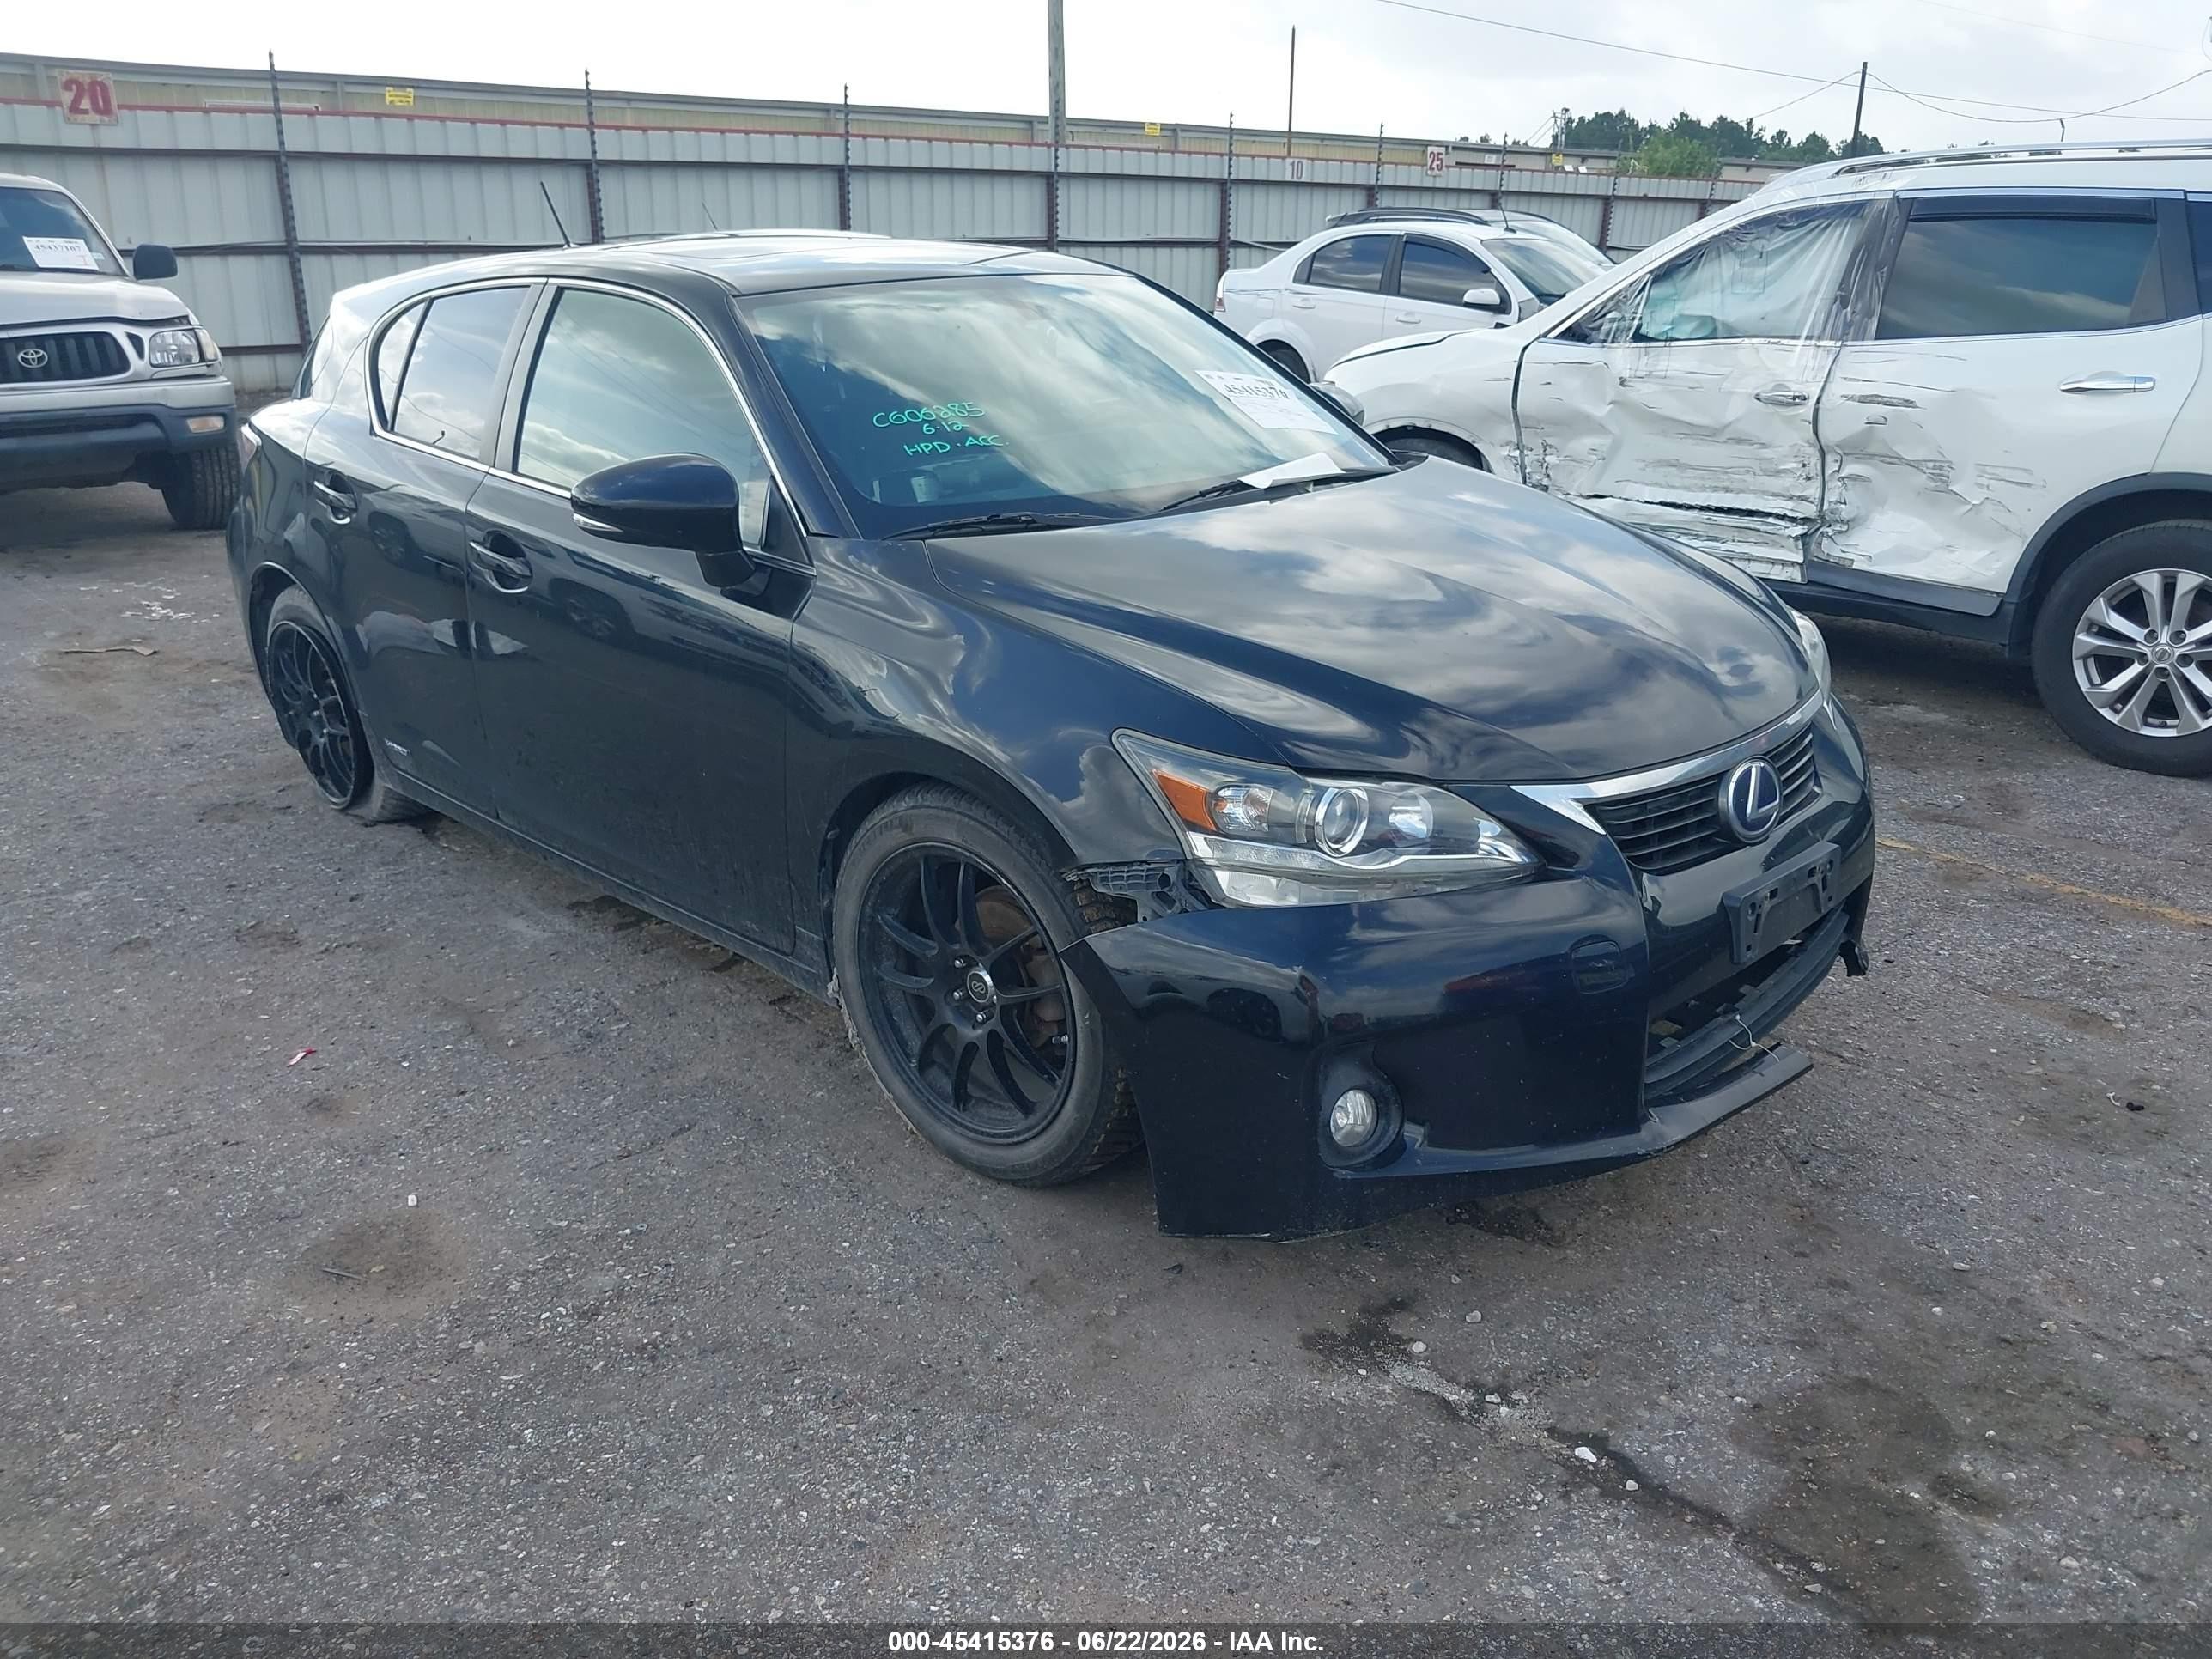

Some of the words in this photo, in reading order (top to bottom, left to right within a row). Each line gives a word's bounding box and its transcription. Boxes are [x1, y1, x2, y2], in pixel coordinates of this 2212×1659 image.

[63, 78, 112, 116] 20
[1290, 161, 1304, 179] 10
[1429, 151, 1443, 171] 25
[1224, 384, 1290, 399] 45415376
[903, 441, 951, 456] HPD
